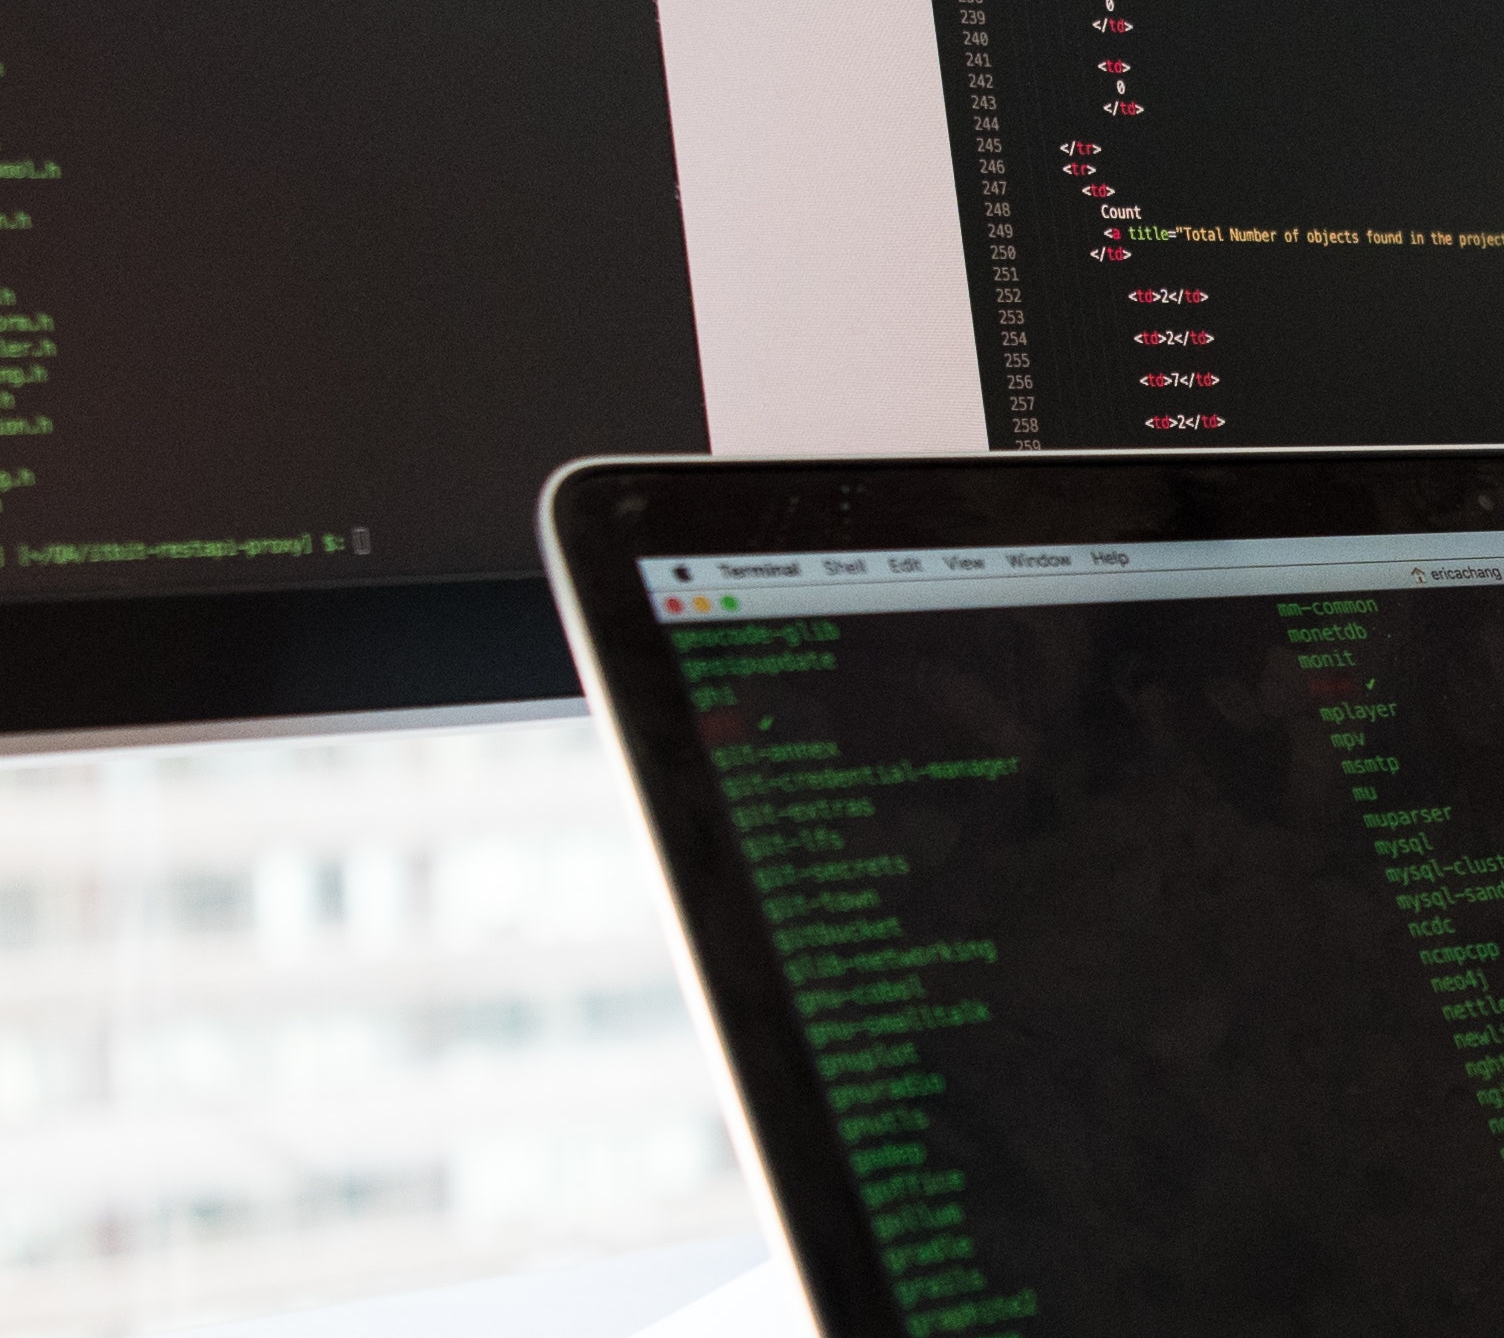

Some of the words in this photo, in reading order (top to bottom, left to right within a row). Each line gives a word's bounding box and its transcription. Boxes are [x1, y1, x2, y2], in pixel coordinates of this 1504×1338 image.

[1099, 201, 1142, 218] Count
[1126, 223, 1223, 241] title="Total
[1228, 225, 1277, 242] Number
[1282, 226, 1299, 242] of
[1305, 226, 1359, 247] objects
[1363, 227, 1402, 244] found
[1407, 228, 1424, 244] in
[1428, 229, 1452, 245] the
[1127, 286, 1208, 307] <td>2</td>
[1132, 328, 1213, 349] <td>2</td>
[1138, 370, 1219, 391] <td>7</td>
[1143, 412, 1225, 433] <td>2</td>
[717, 562, 800, 580] Terminal
[825, 559, 868, 576] Shell
[888, 558, 923, 573] Edit
[942, 556, 985, 571] View
[1005, 553, 1072, 569] Window
[1091, 551, 1130, 568] Help
[1431, 566, 1503, 581] ericachang
[1275, 599, 1378, 616] mm-common
[1285, 621, 1367, 642] monetdb
[1296, 648, 1356, 669] monit
[1318, 701, 1399, 725] mplayer
[1328, 732, 1367, 752] mpv
[1339, 753, 1401, 775] msmtp
[1350, 786, 1377, 801] mu
[1361, 806, 1454, 831] muparser
[1372, 832, 1432, 859] mysql
[1406, 915, 1455, 938] ncdc
[1417, 942, 1501, 966] ncmpcpp
